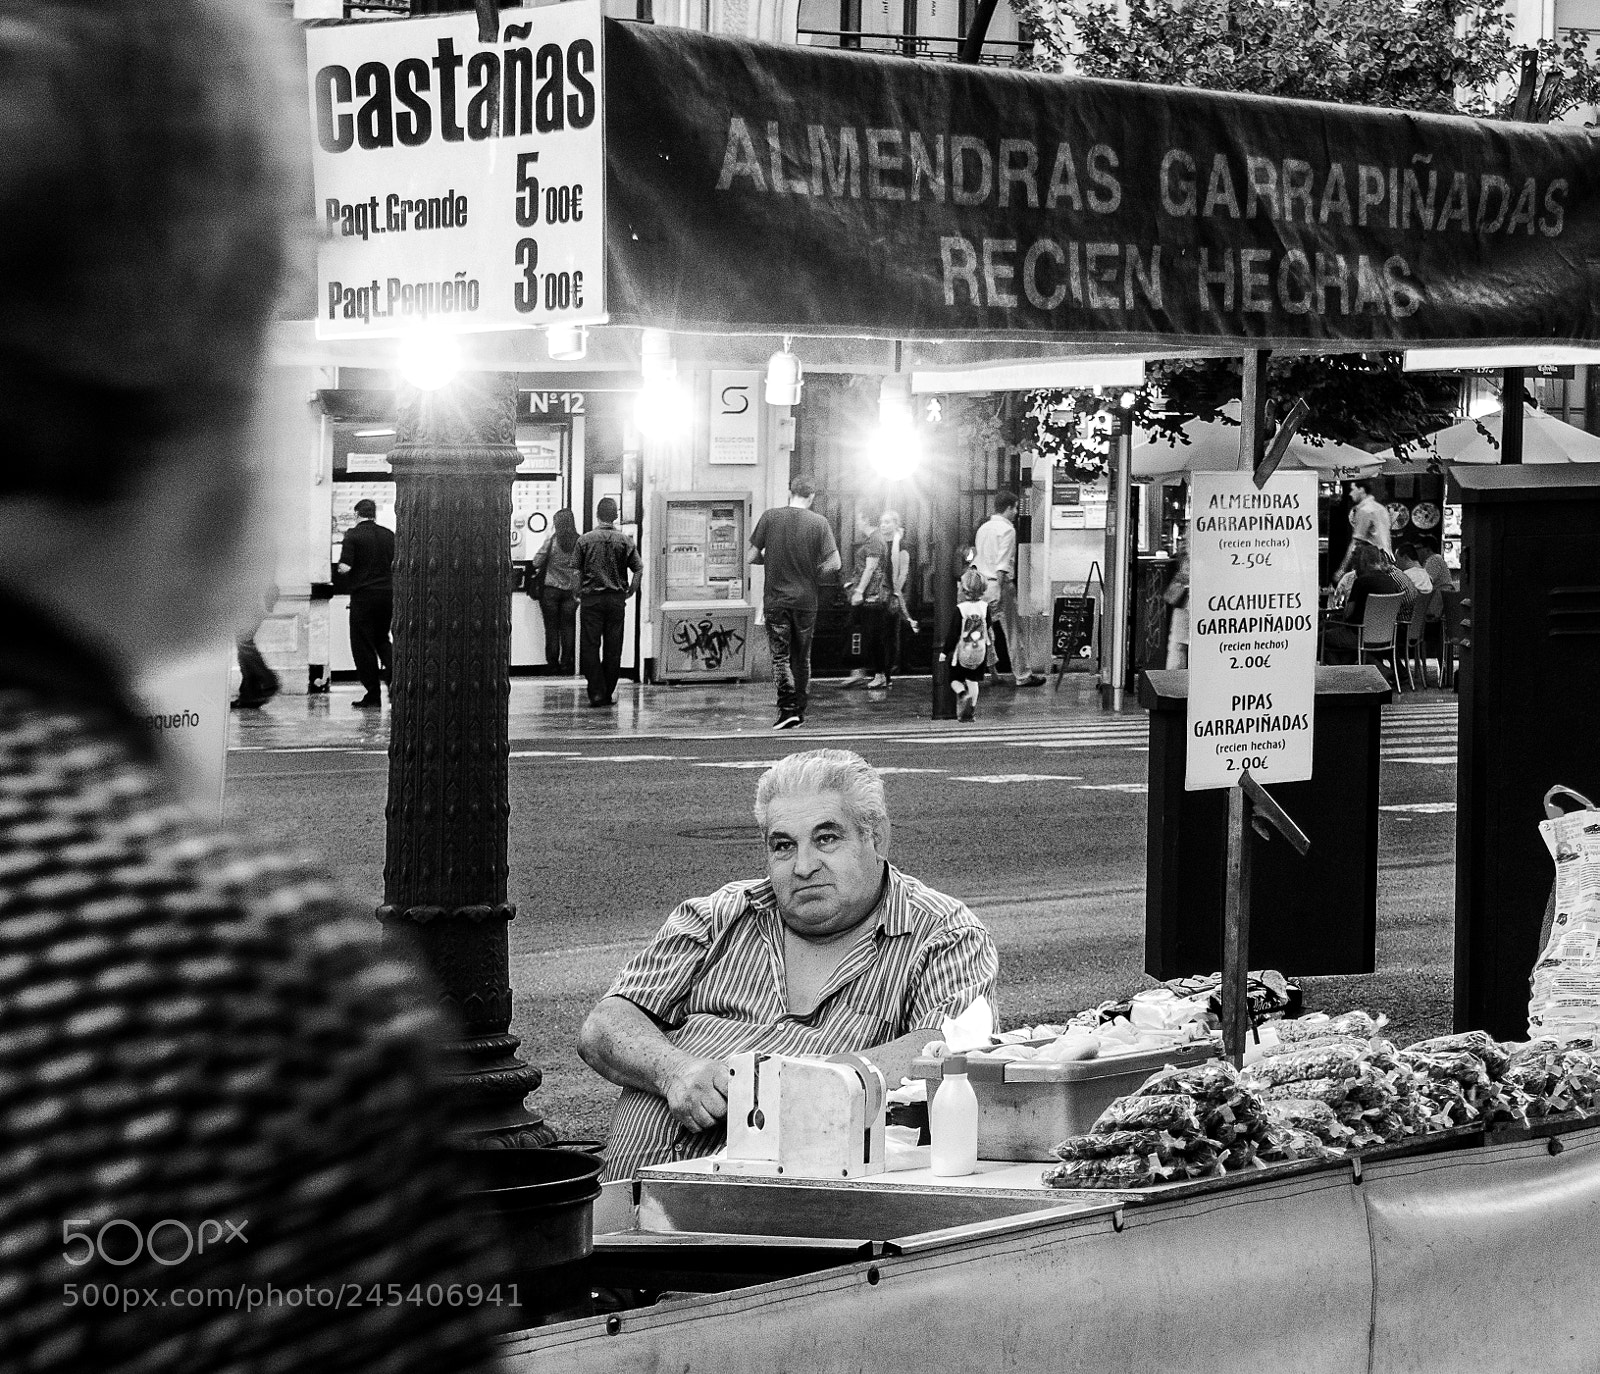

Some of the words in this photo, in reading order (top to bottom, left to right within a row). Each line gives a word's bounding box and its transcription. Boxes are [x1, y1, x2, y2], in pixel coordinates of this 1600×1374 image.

[714, 117, 1122, 214] ALMENDRAS
[1159, 149, 1570, 238] GARRAPIÑADAS
[325, 189, 468, 240] Paqt.Grande
[939, 235, 1164, 312] RECIEN
[1198, 248, 1423, 318] HECHAS
[328, 271, 480, 324] Paqt.Pequeño
[1208, 493, 1300, 510] ALMENDRAS
[1196, 513, 1313, 532] GARRAPIÑADAS
[1218, 538, 1251, 550] (recien
[1254, 537, 1290, 548] hechas)
[1230, 552, 1272, 569] 2.50€
[1208, 592, 1302, 612] CACAHUETES
[1197, 613, 1312, 636] GARRAPIÑADOS
[1219, 641, 1251, 654] (recien
[1254, 639, 1289, 650] hechos)
[1229, 654, 1272, 669] 2.00€
[1231, 692, 1273, 711] PIPAS
[1194, 713, 1309, 737] GARRAPIÑADAS
[1215, 743, 1248, 755] (recien
[1251, 739, 1286, 751] hechas)
[1226, 755, 1269, 771] 2.00€
